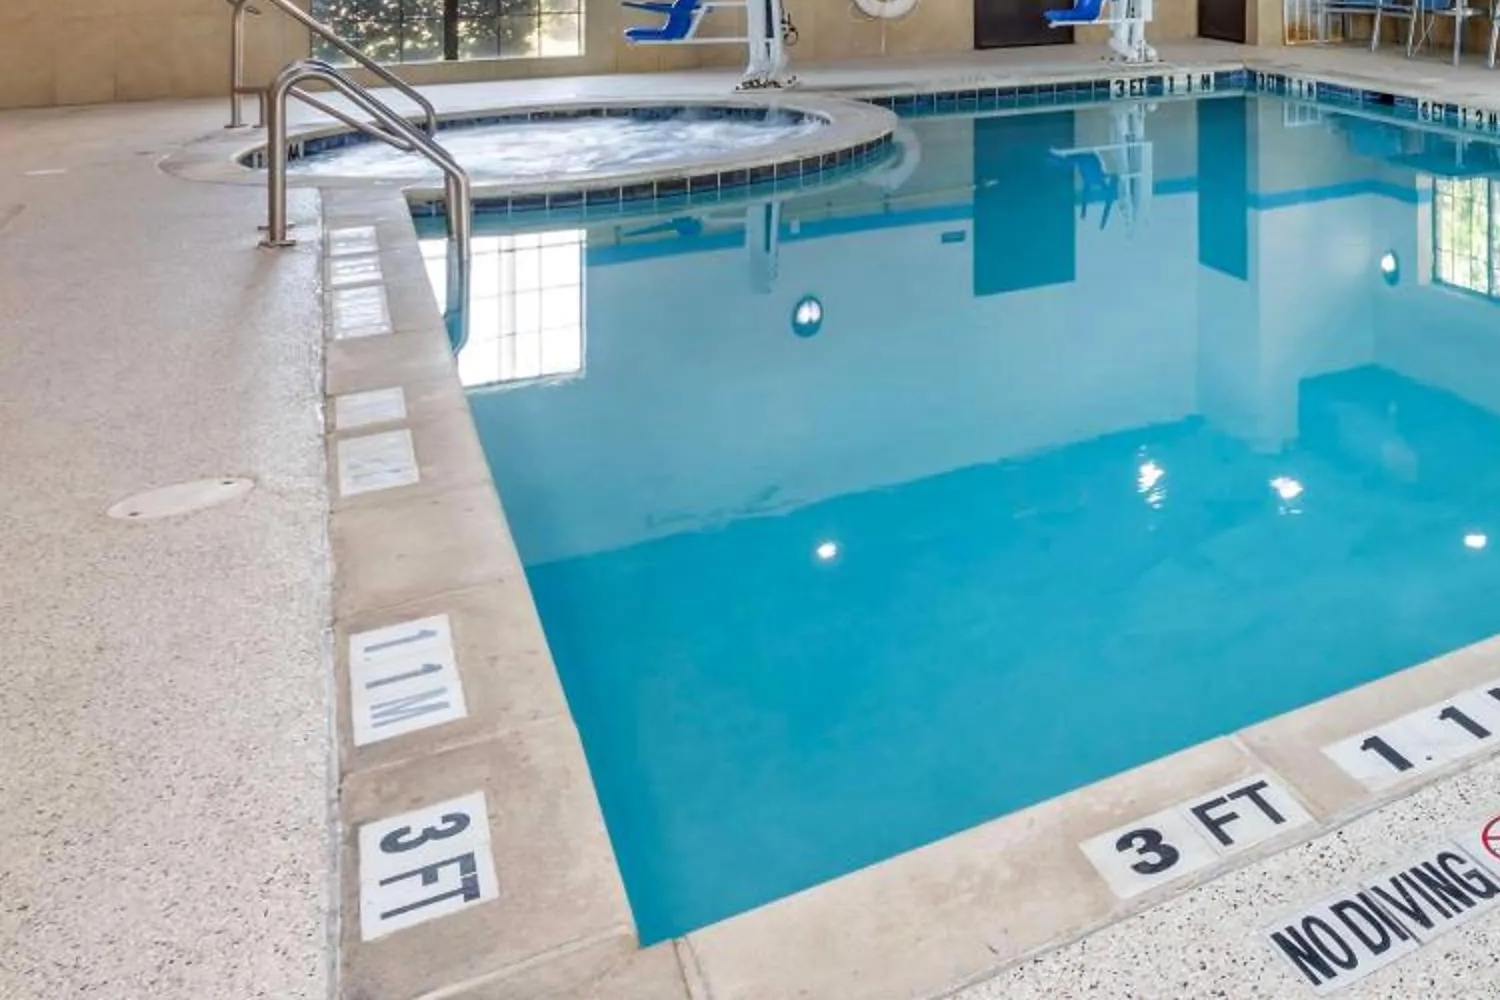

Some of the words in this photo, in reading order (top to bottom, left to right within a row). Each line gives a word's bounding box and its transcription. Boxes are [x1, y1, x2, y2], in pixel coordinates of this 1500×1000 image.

[1361, 705, 1492, 772] 1.1
[379, 811, 471, 854] 3
[1115, 827, 1180, 875] 3
[1191, 779, 1286, 847] FT
[379, 850, 482, 921] FT
[1269, 912, 1360, 986] NO
